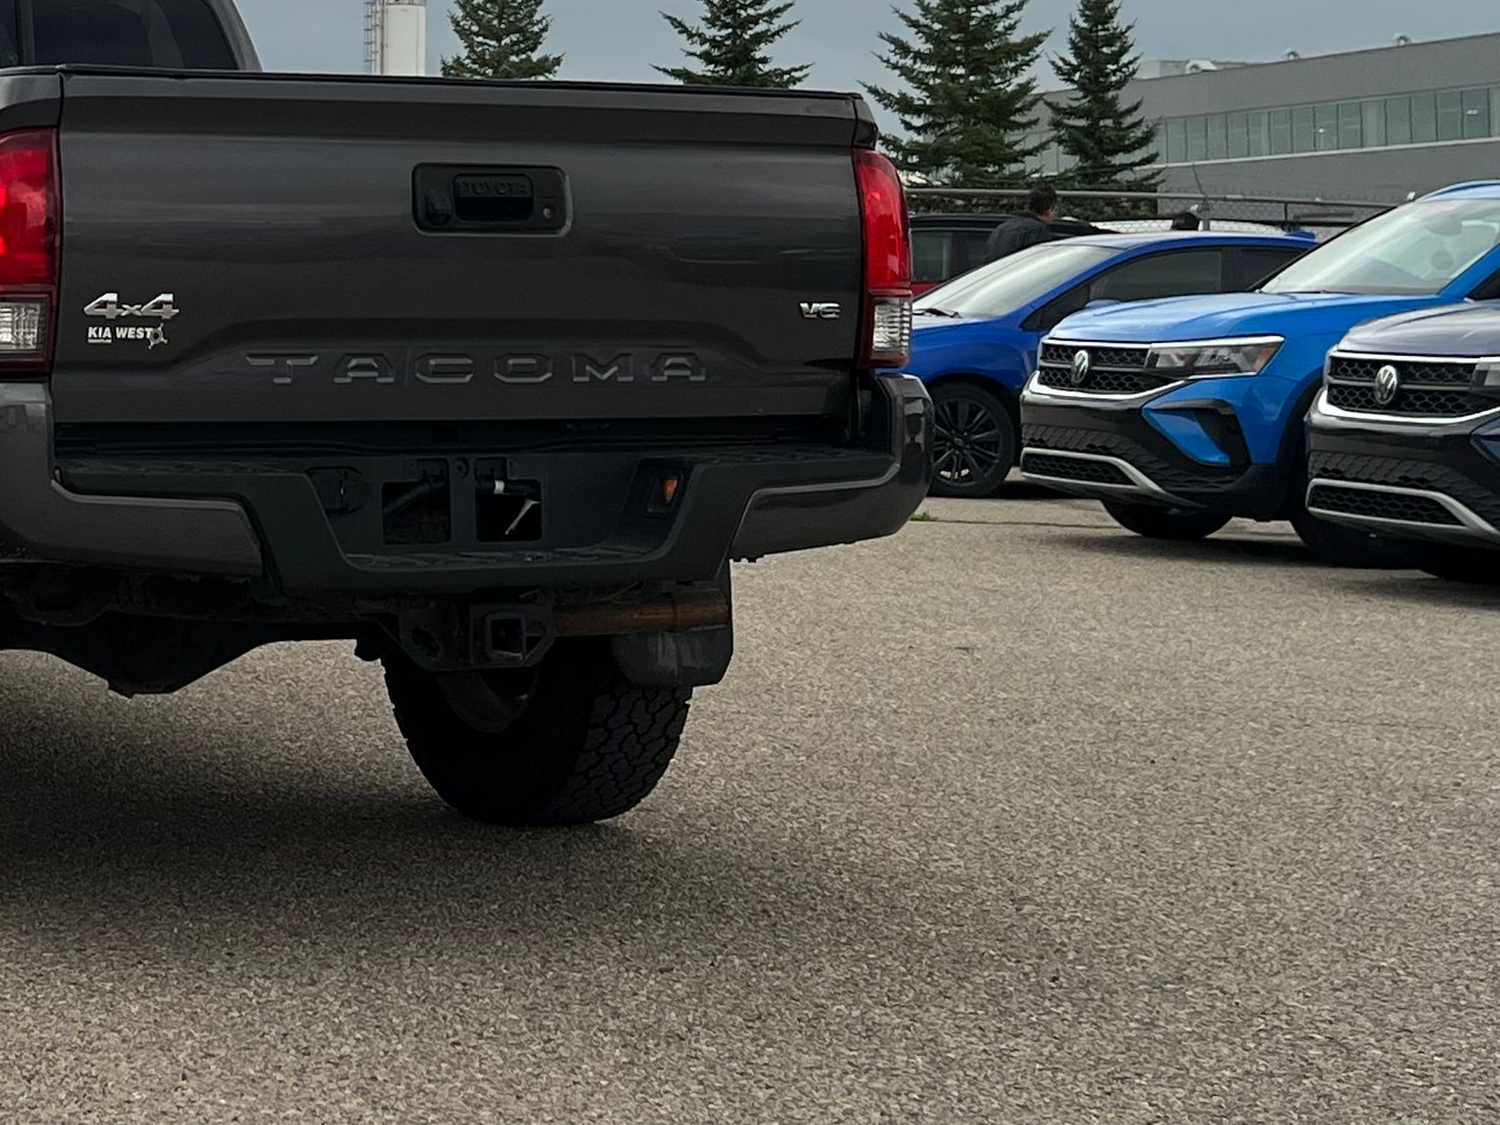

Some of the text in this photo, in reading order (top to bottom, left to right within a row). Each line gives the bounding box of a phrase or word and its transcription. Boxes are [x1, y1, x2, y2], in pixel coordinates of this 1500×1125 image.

[461, 180, 529, 196] TOYOTA
[84, 292, 180, 319] 4x4
[800, 302, 841, 318] V6
[87, 326, 154, 339] KIA WEST
[245, 351, 706, 384] TACOMA
